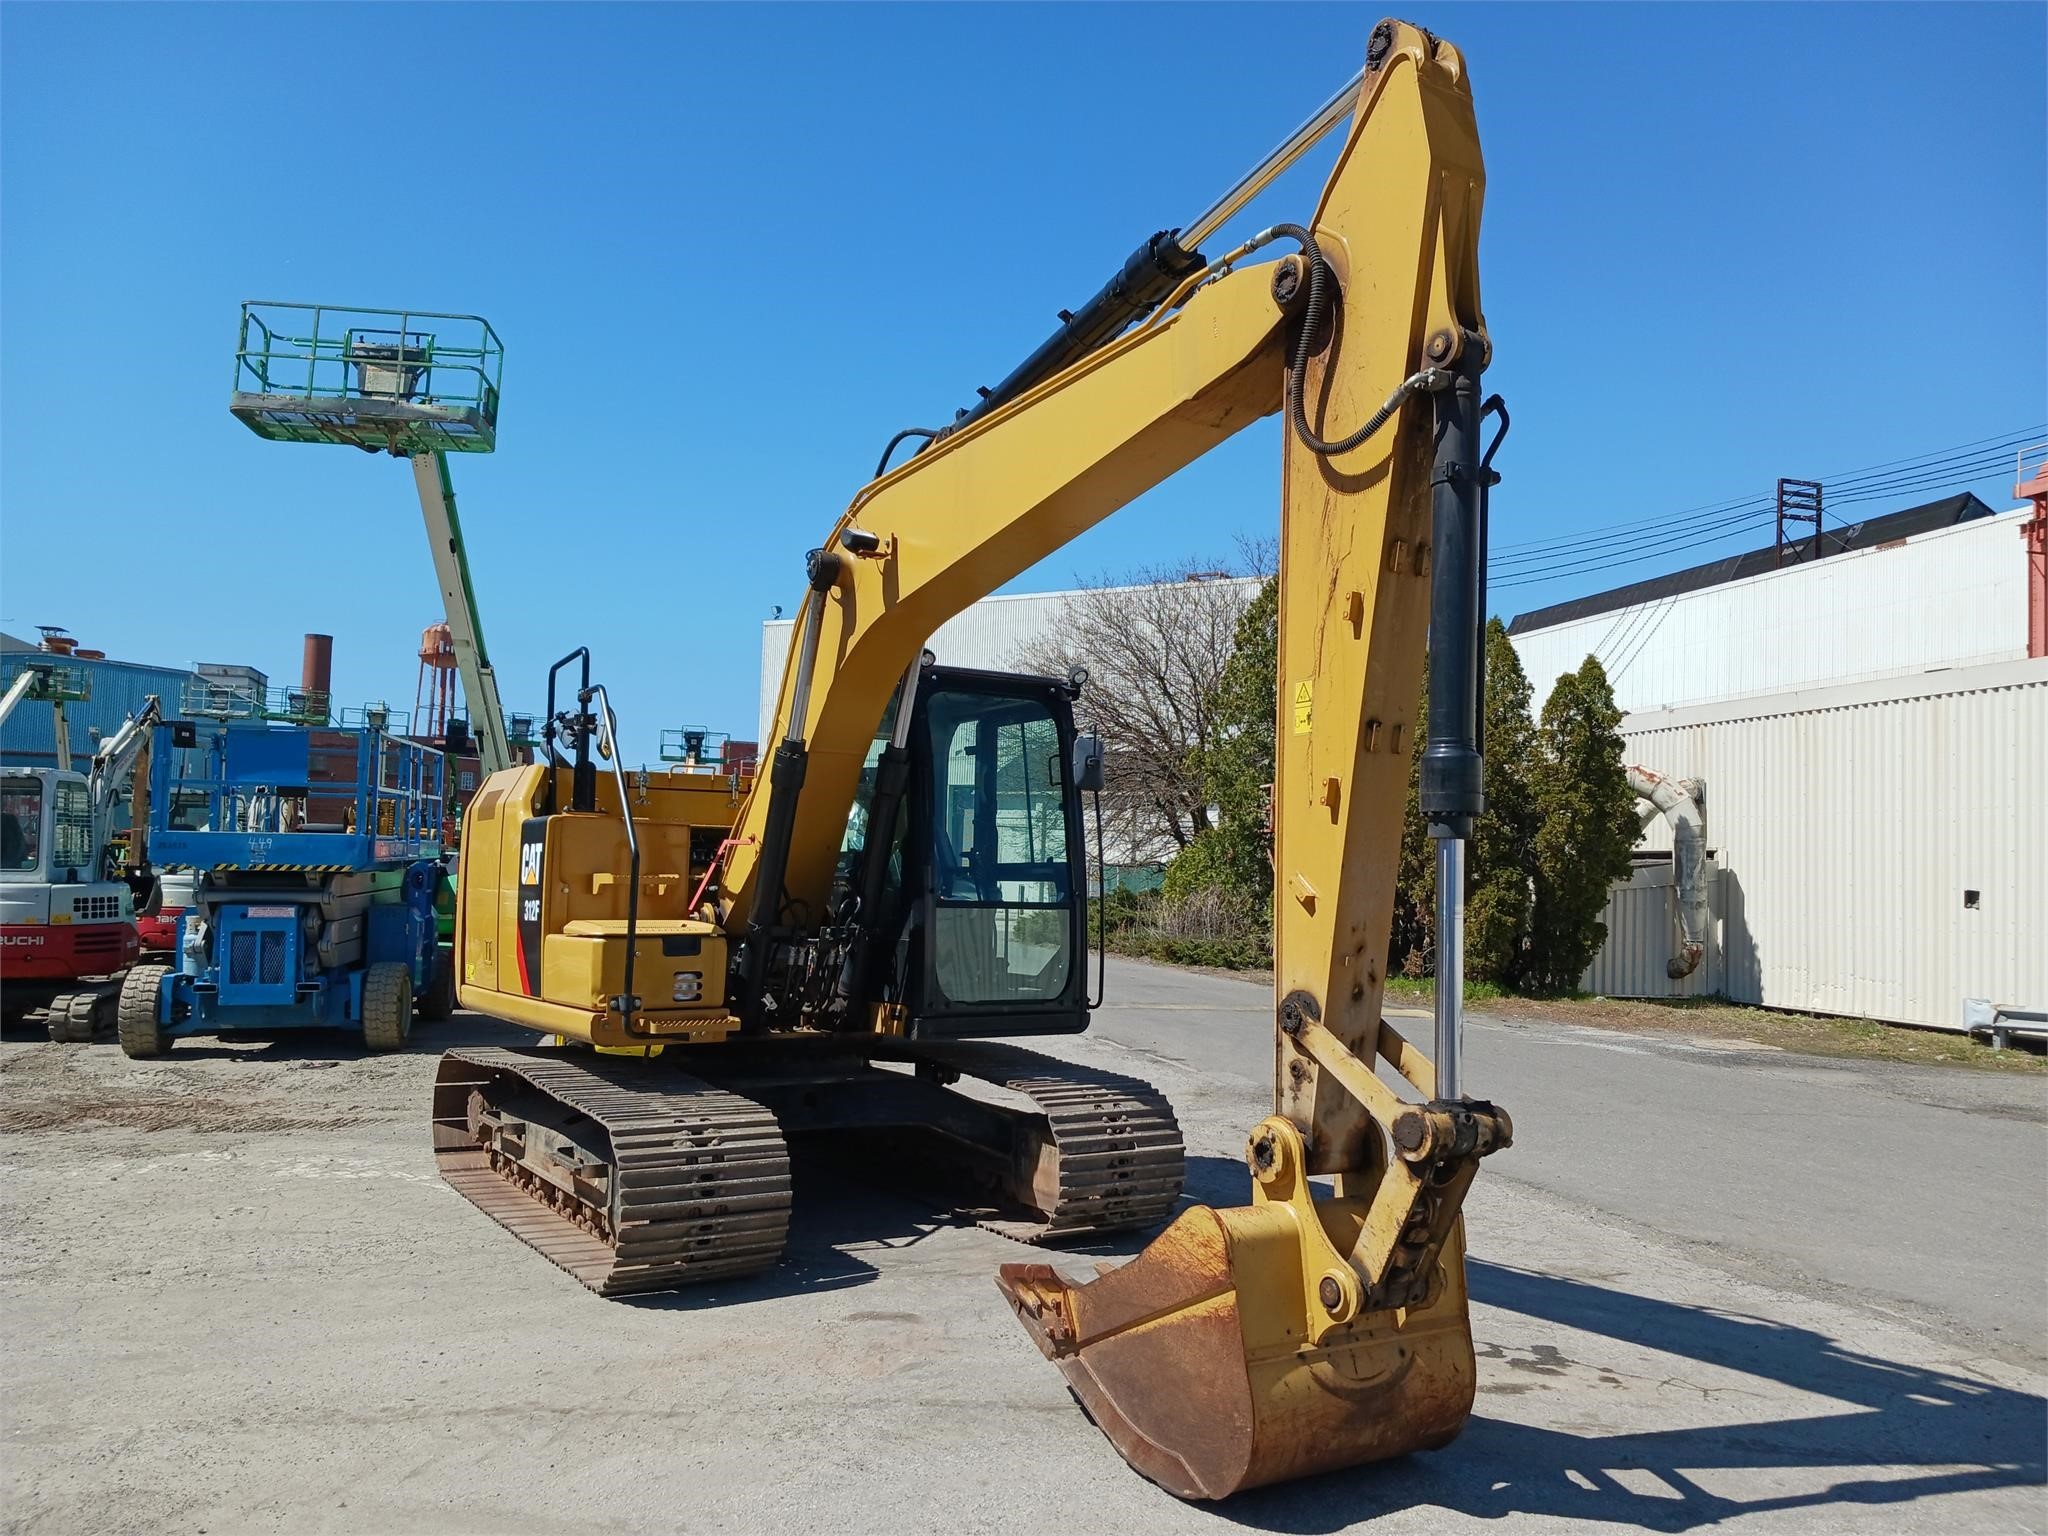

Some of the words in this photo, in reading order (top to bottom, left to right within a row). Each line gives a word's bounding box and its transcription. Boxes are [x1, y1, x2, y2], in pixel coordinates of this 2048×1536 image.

[248, 837, 272, 850] 449
[521, 843, 543, 885] CAT
[524, 900, 540, 921] 312F
